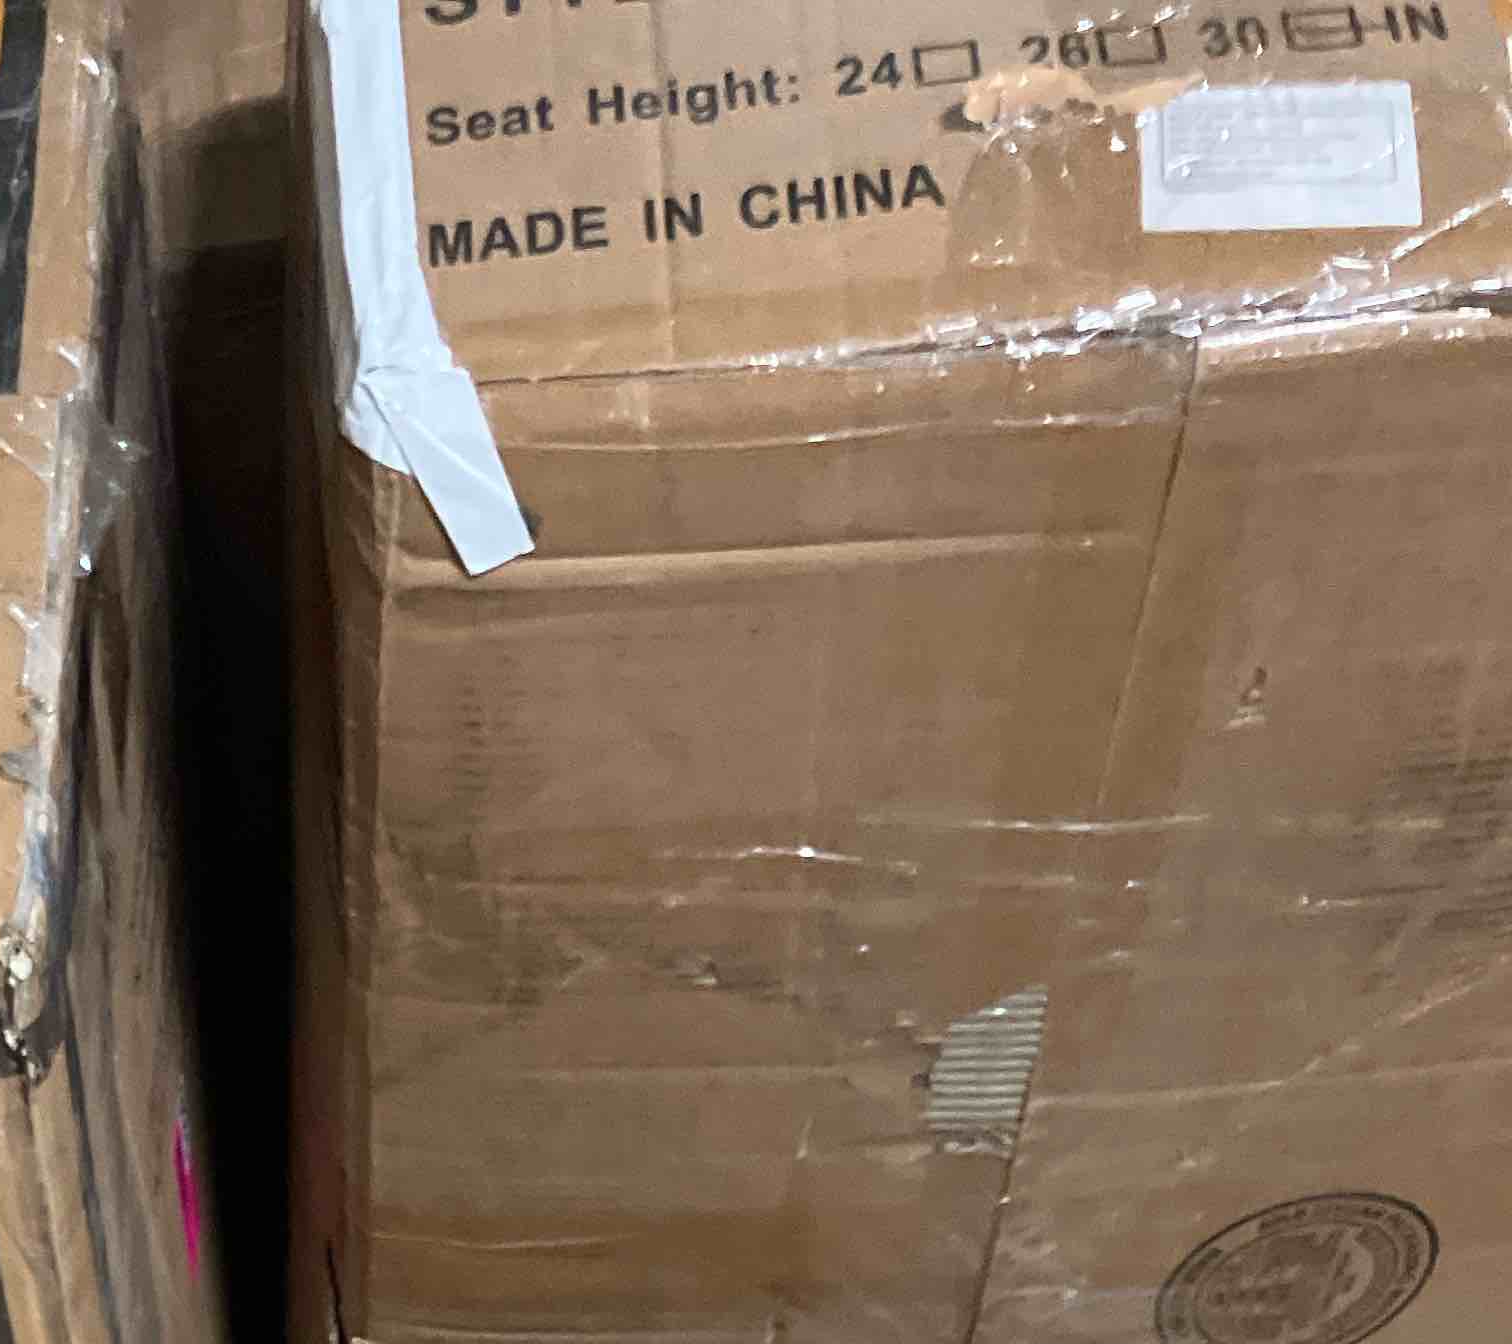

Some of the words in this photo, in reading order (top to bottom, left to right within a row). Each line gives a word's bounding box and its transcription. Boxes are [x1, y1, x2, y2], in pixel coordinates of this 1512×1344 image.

[427, 96, 553, 145] Seat
[588, 69, 800, 125] Height:
[835, 52, 902, 97] 24
[1390, 5, 1449, 43] IN
[429, 206, 609, 267] MADE
[643, 193, 703, 242] IN
[740, 165, 944, 229] CHINA
